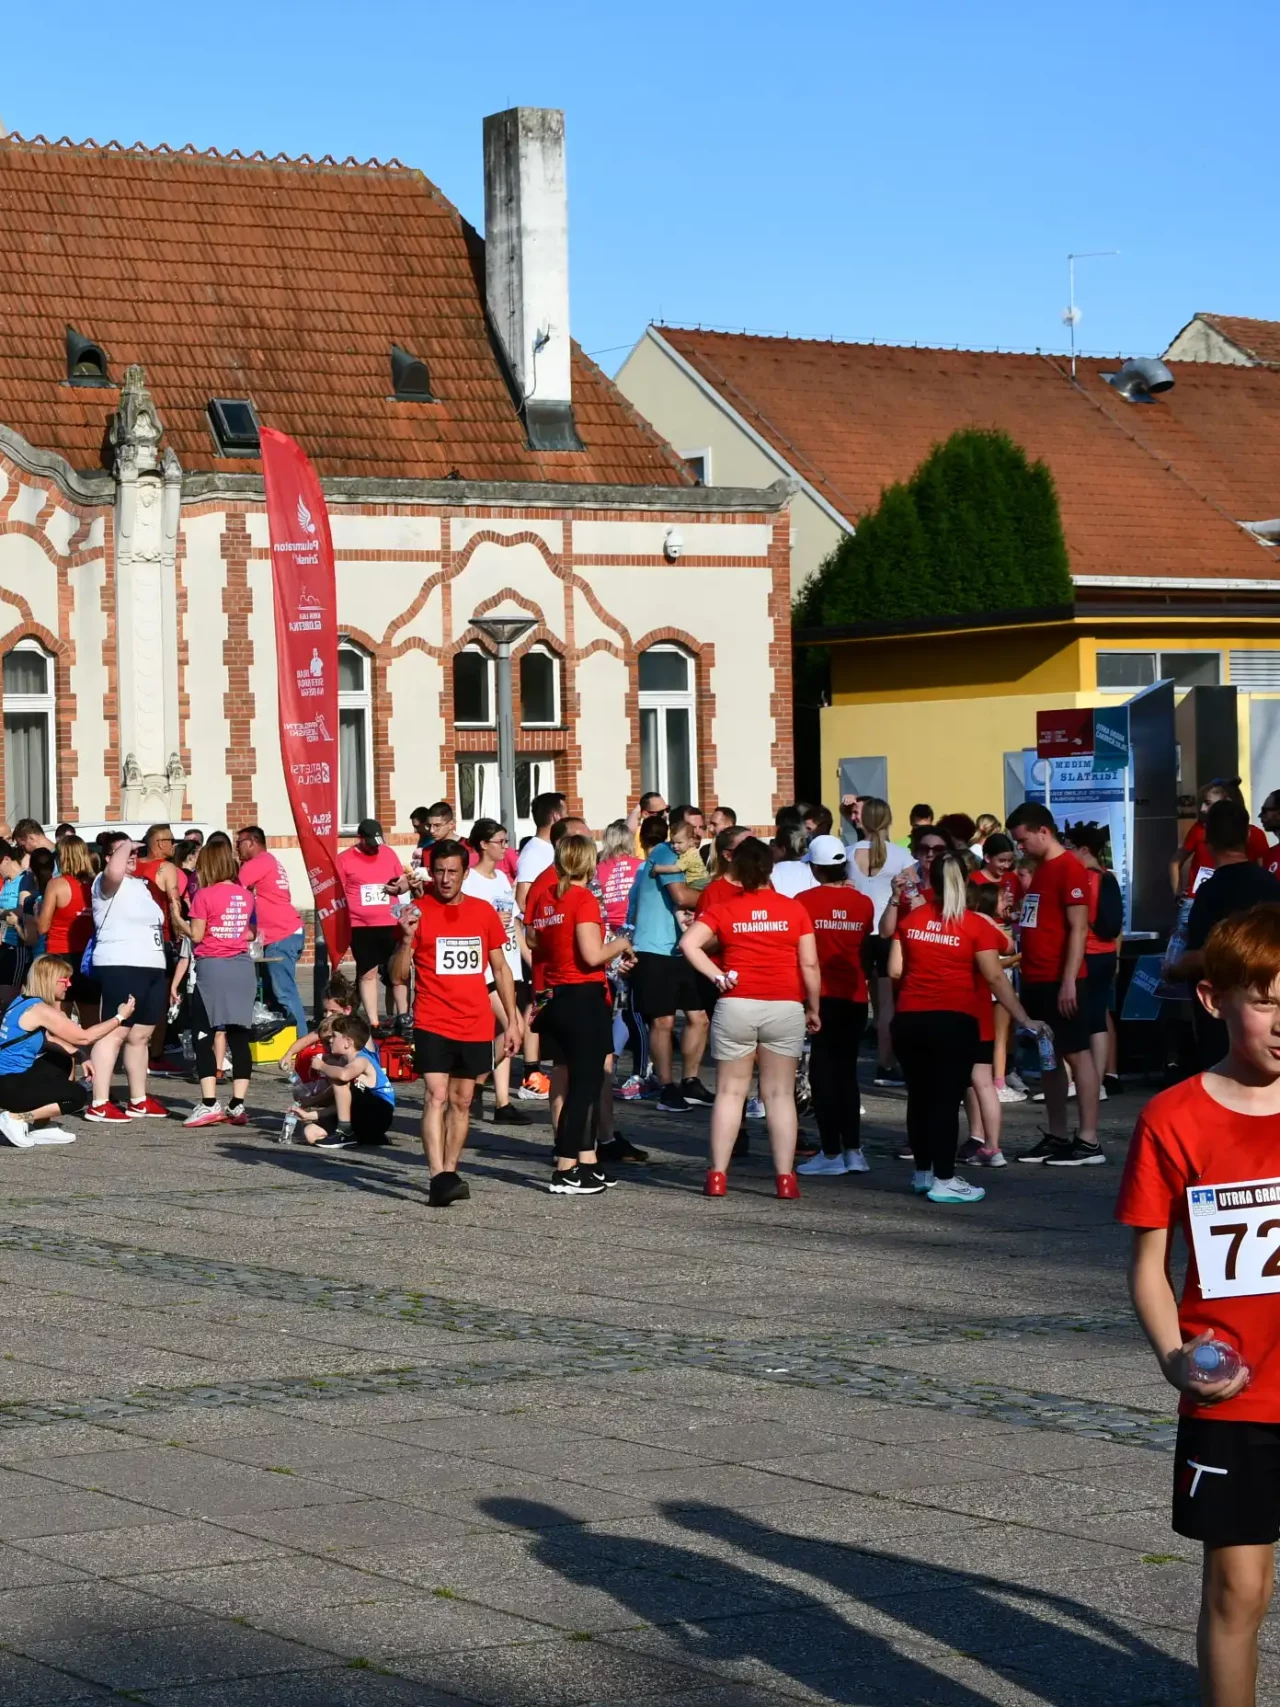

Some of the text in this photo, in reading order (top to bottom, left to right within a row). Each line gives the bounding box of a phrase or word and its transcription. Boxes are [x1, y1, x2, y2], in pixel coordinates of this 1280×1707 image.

[751, 910, 768, 920] DVD
[832, 909, 847, 919] DVD
[732, 921, 789, 933] STRAHONINEC
[814, 919, 864, 931] STRAHONINEC
[926, 919, 942, 932] DVD
[906, 928, 961, 947] STRAHONINEC
[443, 950, 479, 970] 599
[1218, 1186, 1280, 1207] UTRKA GRAD
